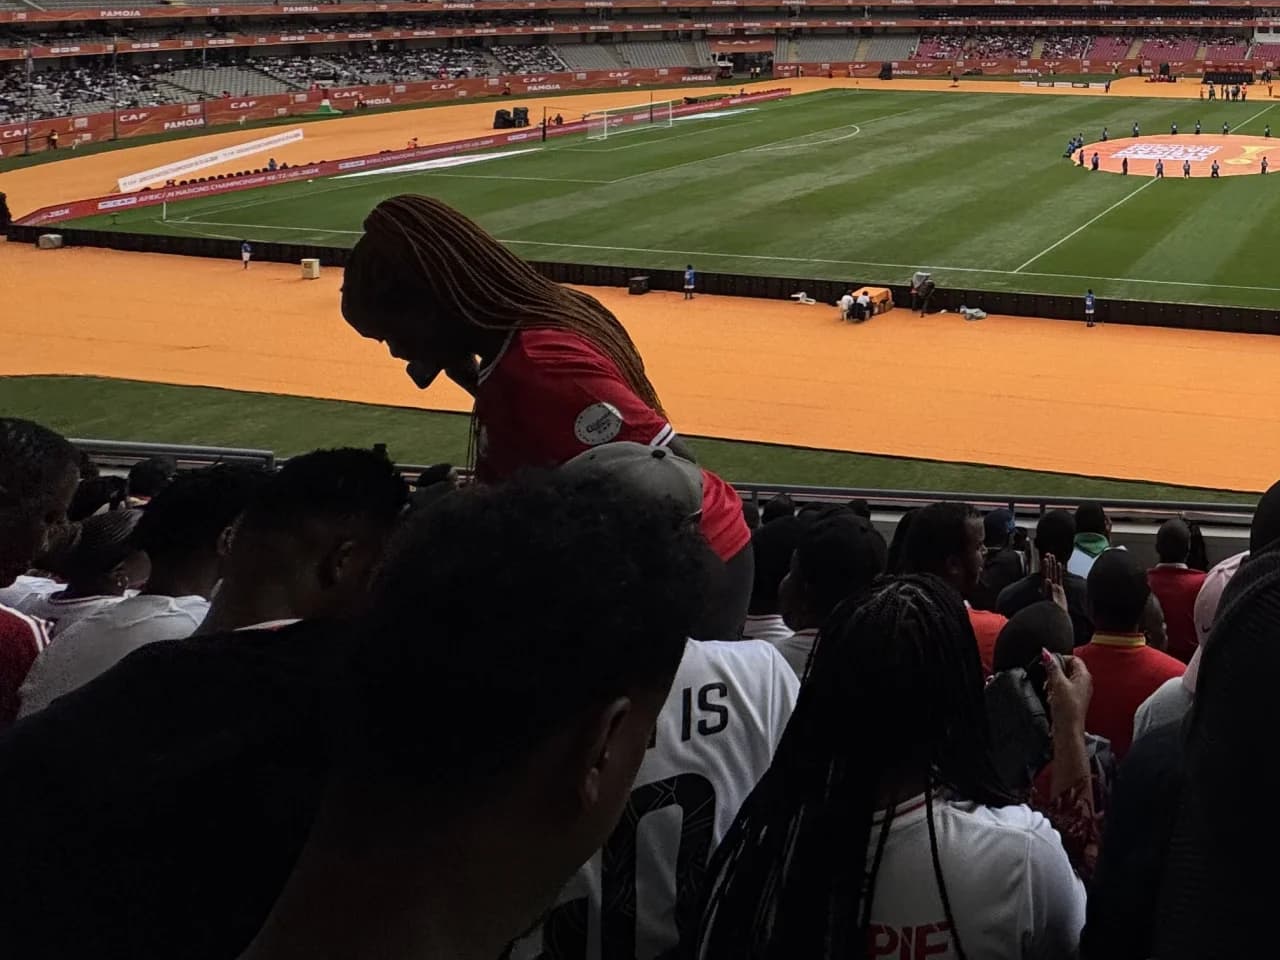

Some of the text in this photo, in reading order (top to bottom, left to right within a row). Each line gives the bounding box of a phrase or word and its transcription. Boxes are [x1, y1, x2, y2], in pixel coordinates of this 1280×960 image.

[230, 101, 257, 109] CAF
[119, 113, 148, 122] CAF
[164, 118, 205, 130] PAMOJA
[210, 176, 265, 191] CHAMPIONSHIP
